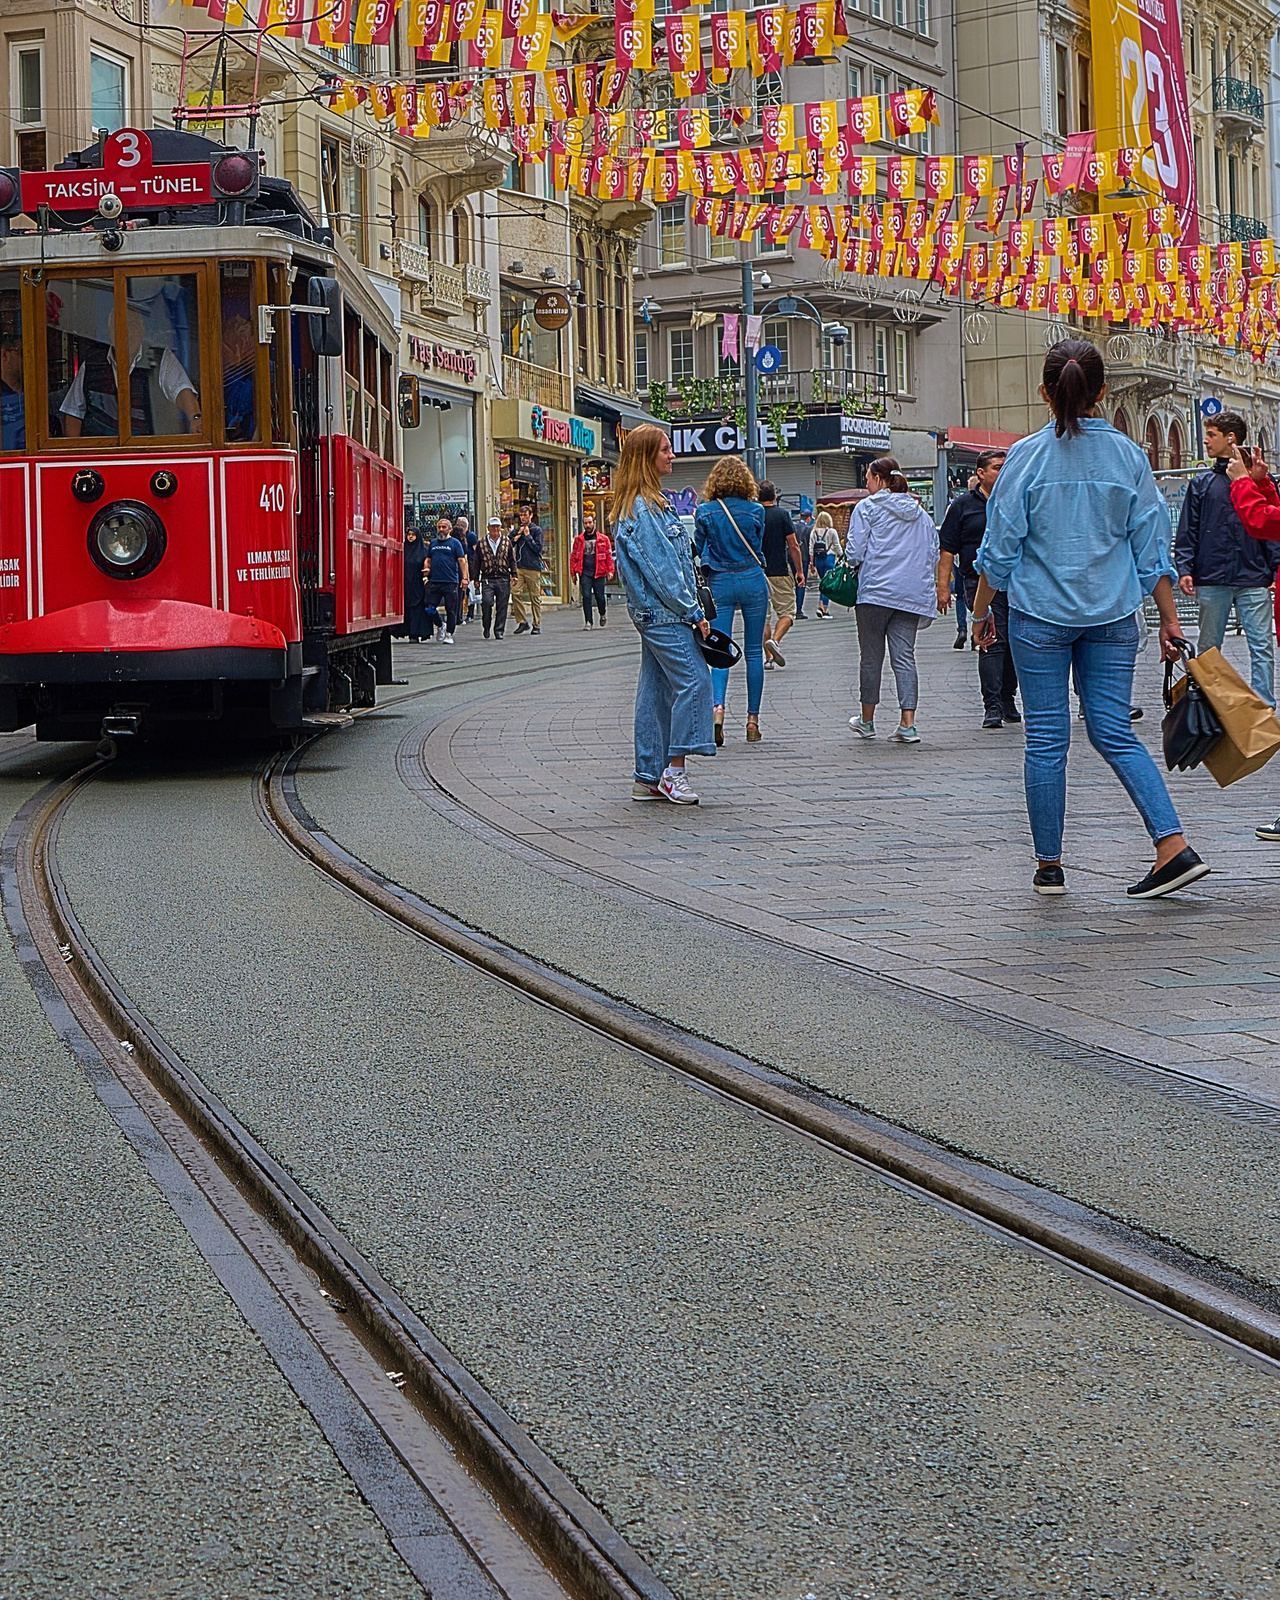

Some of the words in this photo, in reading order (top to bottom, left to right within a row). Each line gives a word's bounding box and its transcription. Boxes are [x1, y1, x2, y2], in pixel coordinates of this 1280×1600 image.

[115, 132, 141, 167] 3
[45, 178, 115, 198] TAKSİM
[140, 176, 203, 194] TÜNEL
[570, 417, 596, 456] kitap
[260, 483, 285, 512] 410
[247, 550, 272, 564] ILMAK
[237, 569, 248, 581] VE
[250, 564, 291, 581] TEHLİKELİDİR
